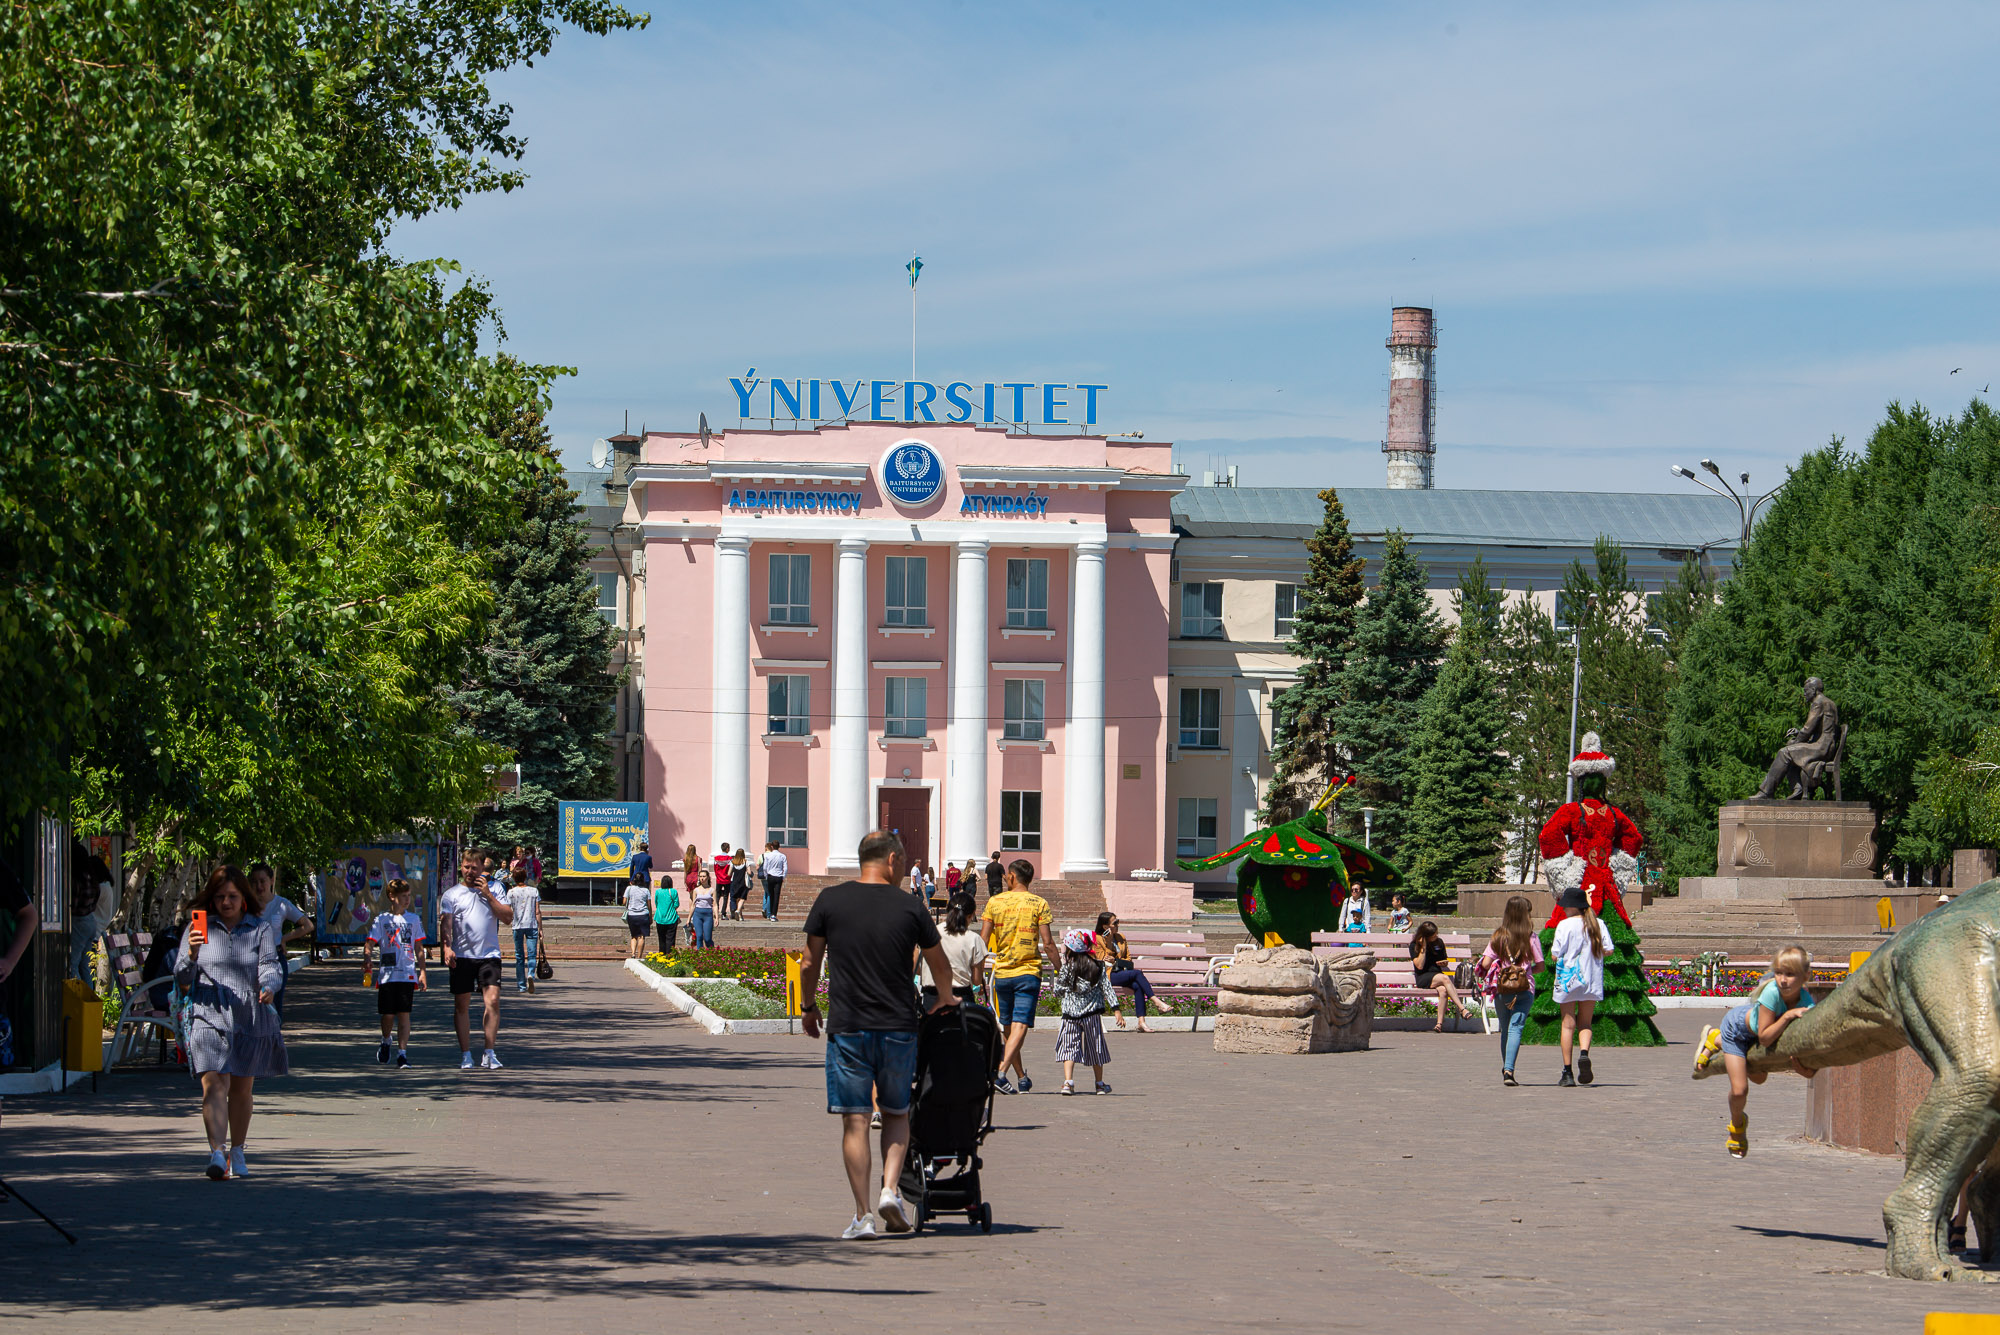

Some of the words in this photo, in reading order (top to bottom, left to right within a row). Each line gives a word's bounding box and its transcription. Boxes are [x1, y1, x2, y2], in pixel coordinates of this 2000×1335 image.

[727, 366, 1109, 425] ÝNIVERSITET
[729, 490, 862, 511] A.BAITURSYNOV
[960, 490, 1050, 514] ATYNDAǴY
[580, 807, 628, 816] ҚАЗАҚСТАН
[580, 825, 627, 864] 30
[610, 825, 630, 833] ЖЫЛ
